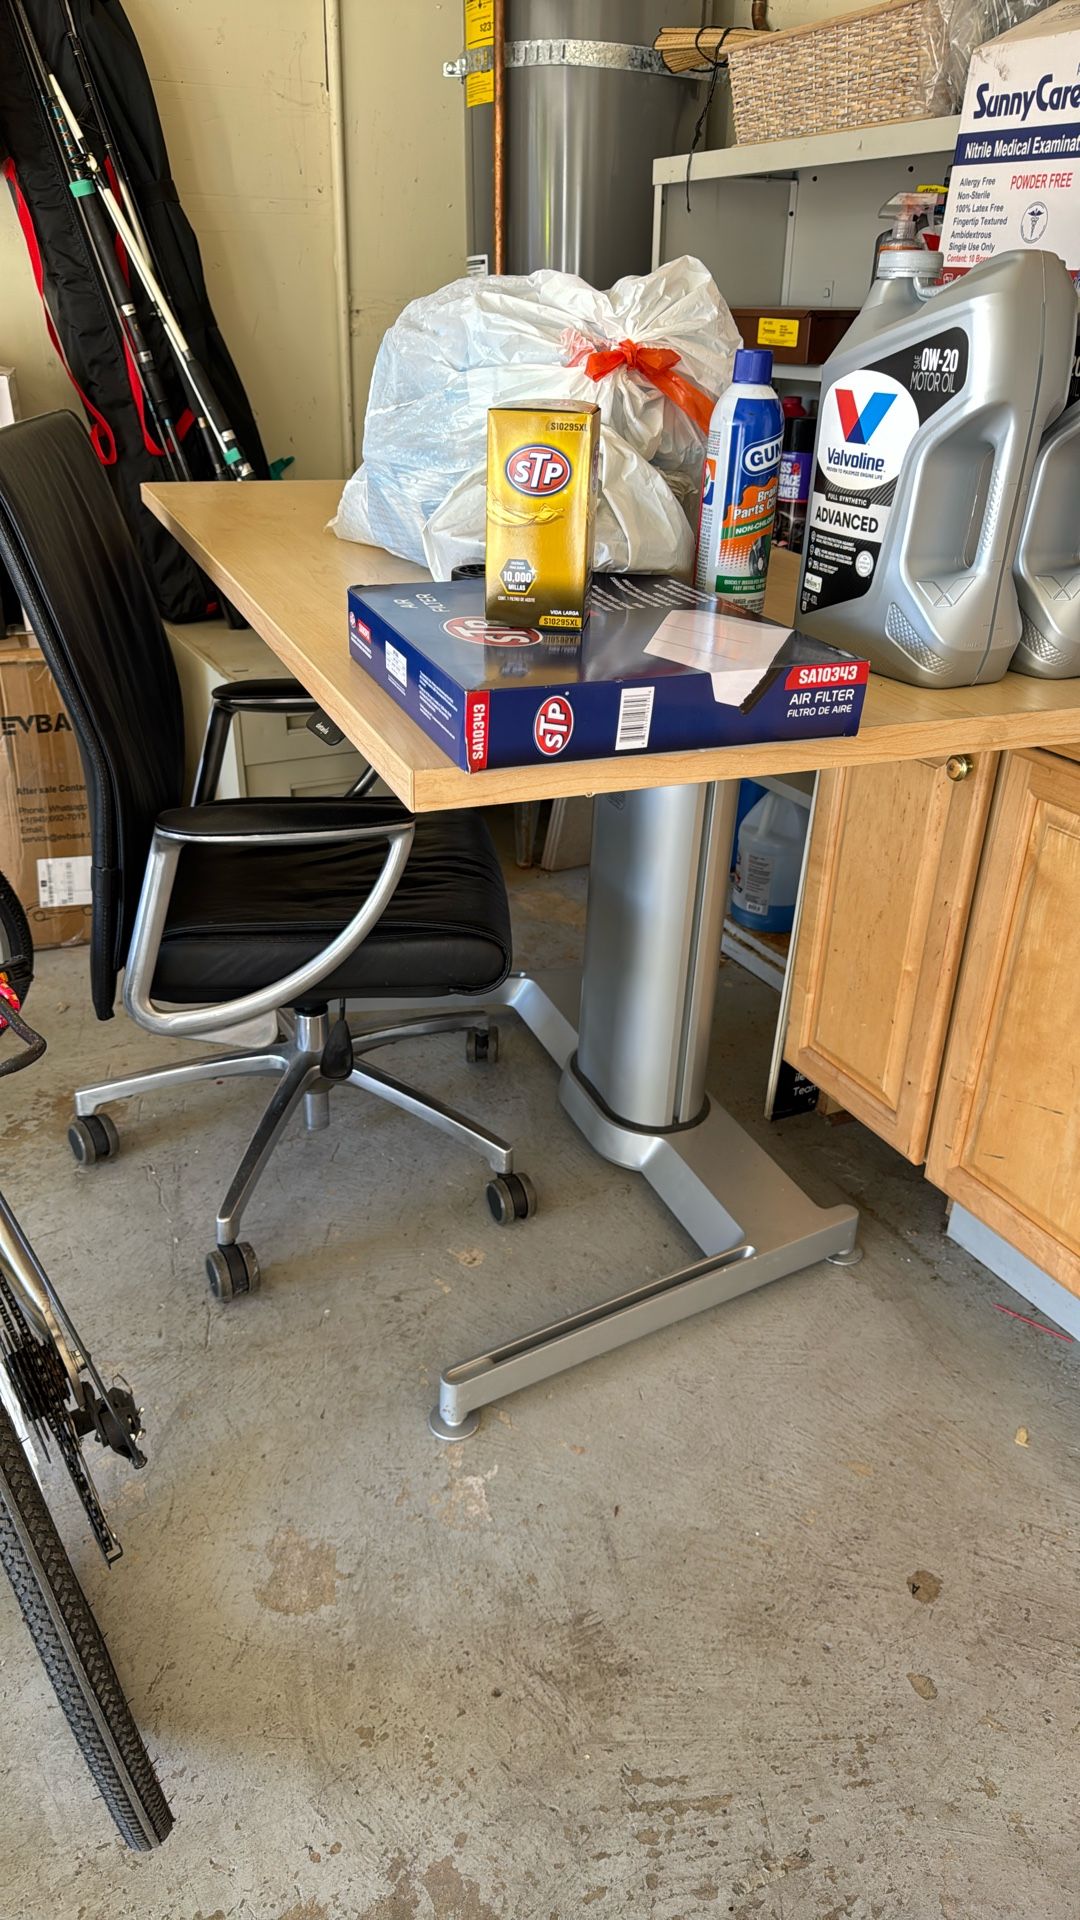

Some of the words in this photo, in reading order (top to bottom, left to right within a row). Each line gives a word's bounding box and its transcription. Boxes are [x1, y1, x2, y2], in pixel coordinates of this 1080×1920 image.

[973, 73, 1080, 121] SunnyCare
[965, 141, 992, 159] Nitrile
[993, 138, 1032, 157] Medical
[960, 177, 981, 189] Allergy
[982, 176, 996, 186] Free
[1010, 174, 1047, 190] POWDER
[1049, 172, 1073, 188] FREE
[957, 190, 990, 200] Non-Sterile
[955, 204, 971, 213] 100%
[972, 203, 989, 213] Latex
[990, 203, 1004, 212] Free
[952, 216, 979, 228] Fingertip
[980, 216, 1008, 226] Textured
[950, 229, 992, 239] Ambidextrous
[949, 242, 967, 253] Single
[967, 242, 980, 251] Use
[980, 242, 996, 253] Only
[968, 254, 975, 263] 10
[913, 355, 921, 369] SAE
[921, 348, 959, 373] 0W-20
[910, 371, 940, 392] MOTOR
[941, 373, 955, 393] OIL
[550, 422, 588, 432] S10295XL
[828, 447, 885, 472] Valvoline
[513, 452, 564, 488] STP
[828, 492, 838, 501] FULL
[839, 495, 867, 506] SYNTHETIC
[734, 504, 764, 520] Parts
[815, 506, 879, 533] ADVANCED
[503, 571, 532, 584] 10,000
[544, 617, 579, 627] S10295XL
[798, 665, 858, 685] SA10343
[789, 692, 811, 706] AIR
[814, 688, 855, 703] FILTER
[787, 706, 816, 718] FILTRO
[818, 705, 830, 715] DE
[831, 704, 853, 714] AIRE
[472, 703, 486, 760] SA10343
[539, 702, 569, 749] STP
[16, 786, 37, 795] After
[39, 785, 57, 794] sale
